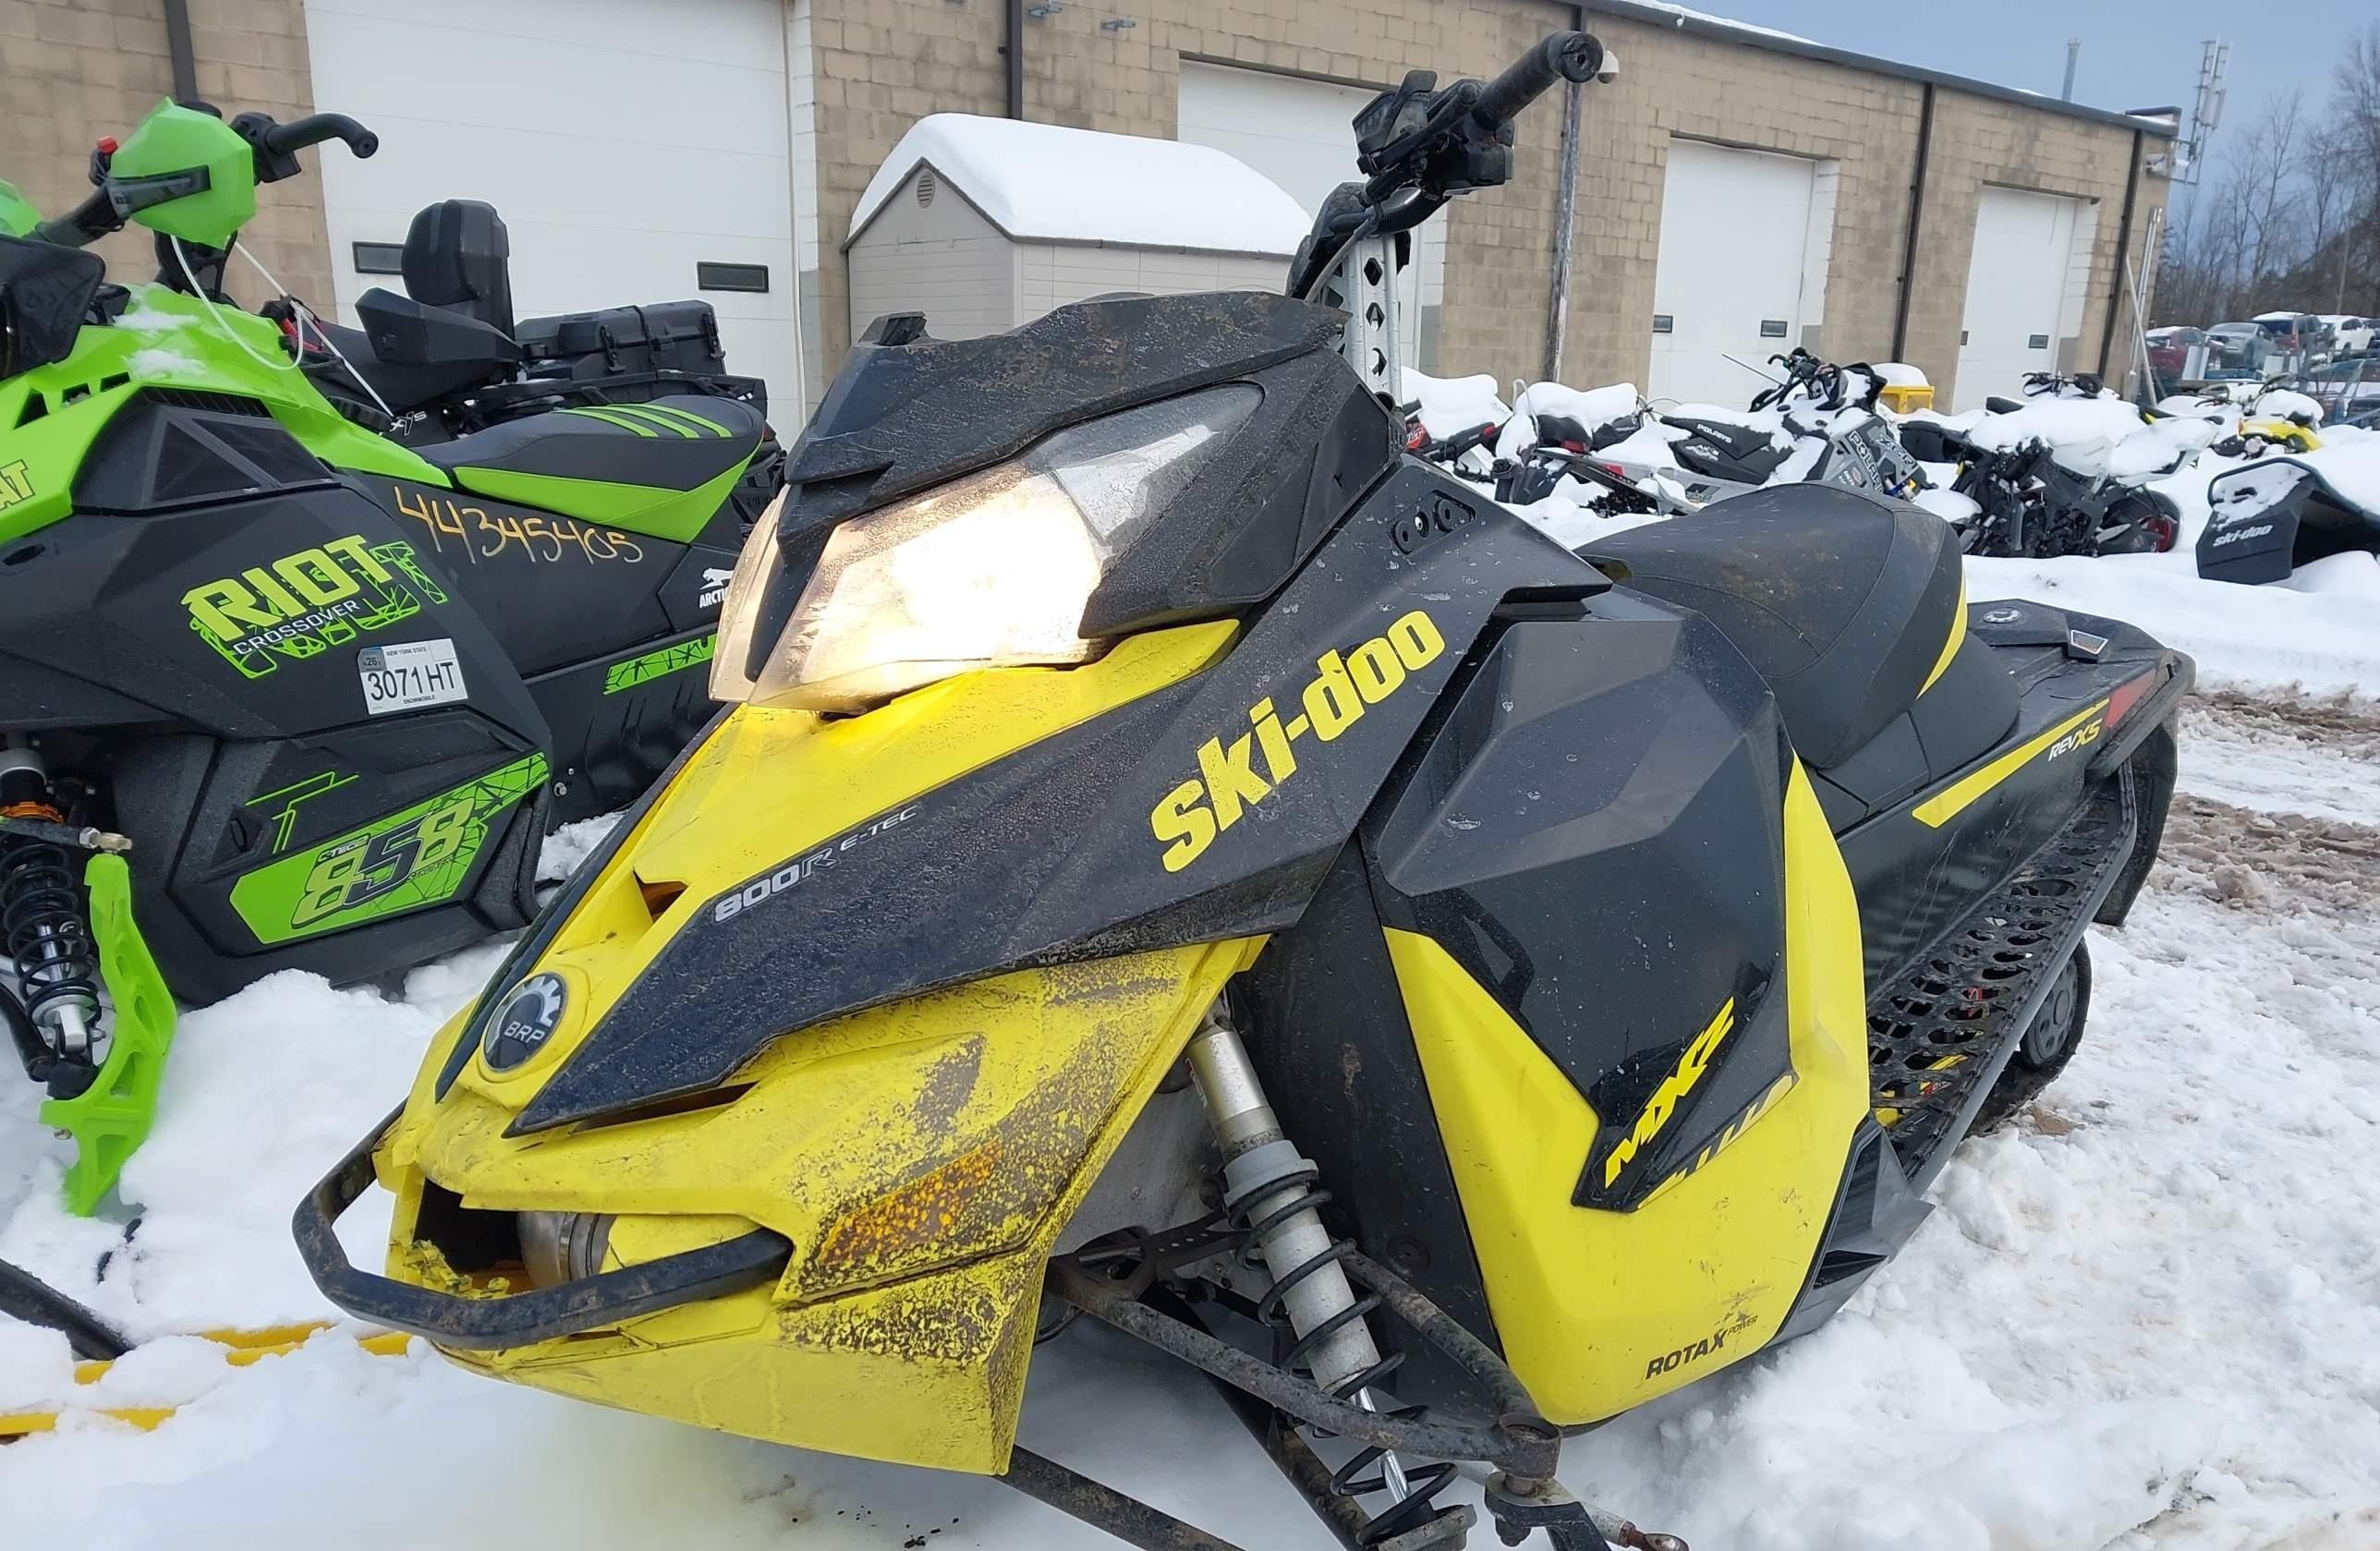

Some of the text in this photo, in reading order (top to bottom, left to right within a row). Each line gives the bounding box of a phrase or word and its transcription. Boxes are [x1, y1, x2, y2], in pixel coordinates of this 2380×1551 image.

[1697, 423, 1732, 443] POLARIS
[394, 486, 644, 564] 44345405
[2212, 524, 2274, 548] ski-doo
[181, 534, 394, 642] RIOT
[232, 600, 361, 656] CROSSOVER
[412, 646, 428, 654] STATE
[368, 661, 455, 701] 3071 HT
[403, 694, 436, 705] SNOWMOBILE
[1150, 610, 1446, 874] ski-doo
[840, 804, 918, 852] E-TEC
[291, 797, 476, 930] 858
[503, 1020, 546, 1044] BRP
[1645, 1327, 1729, 1381] ROTAX
